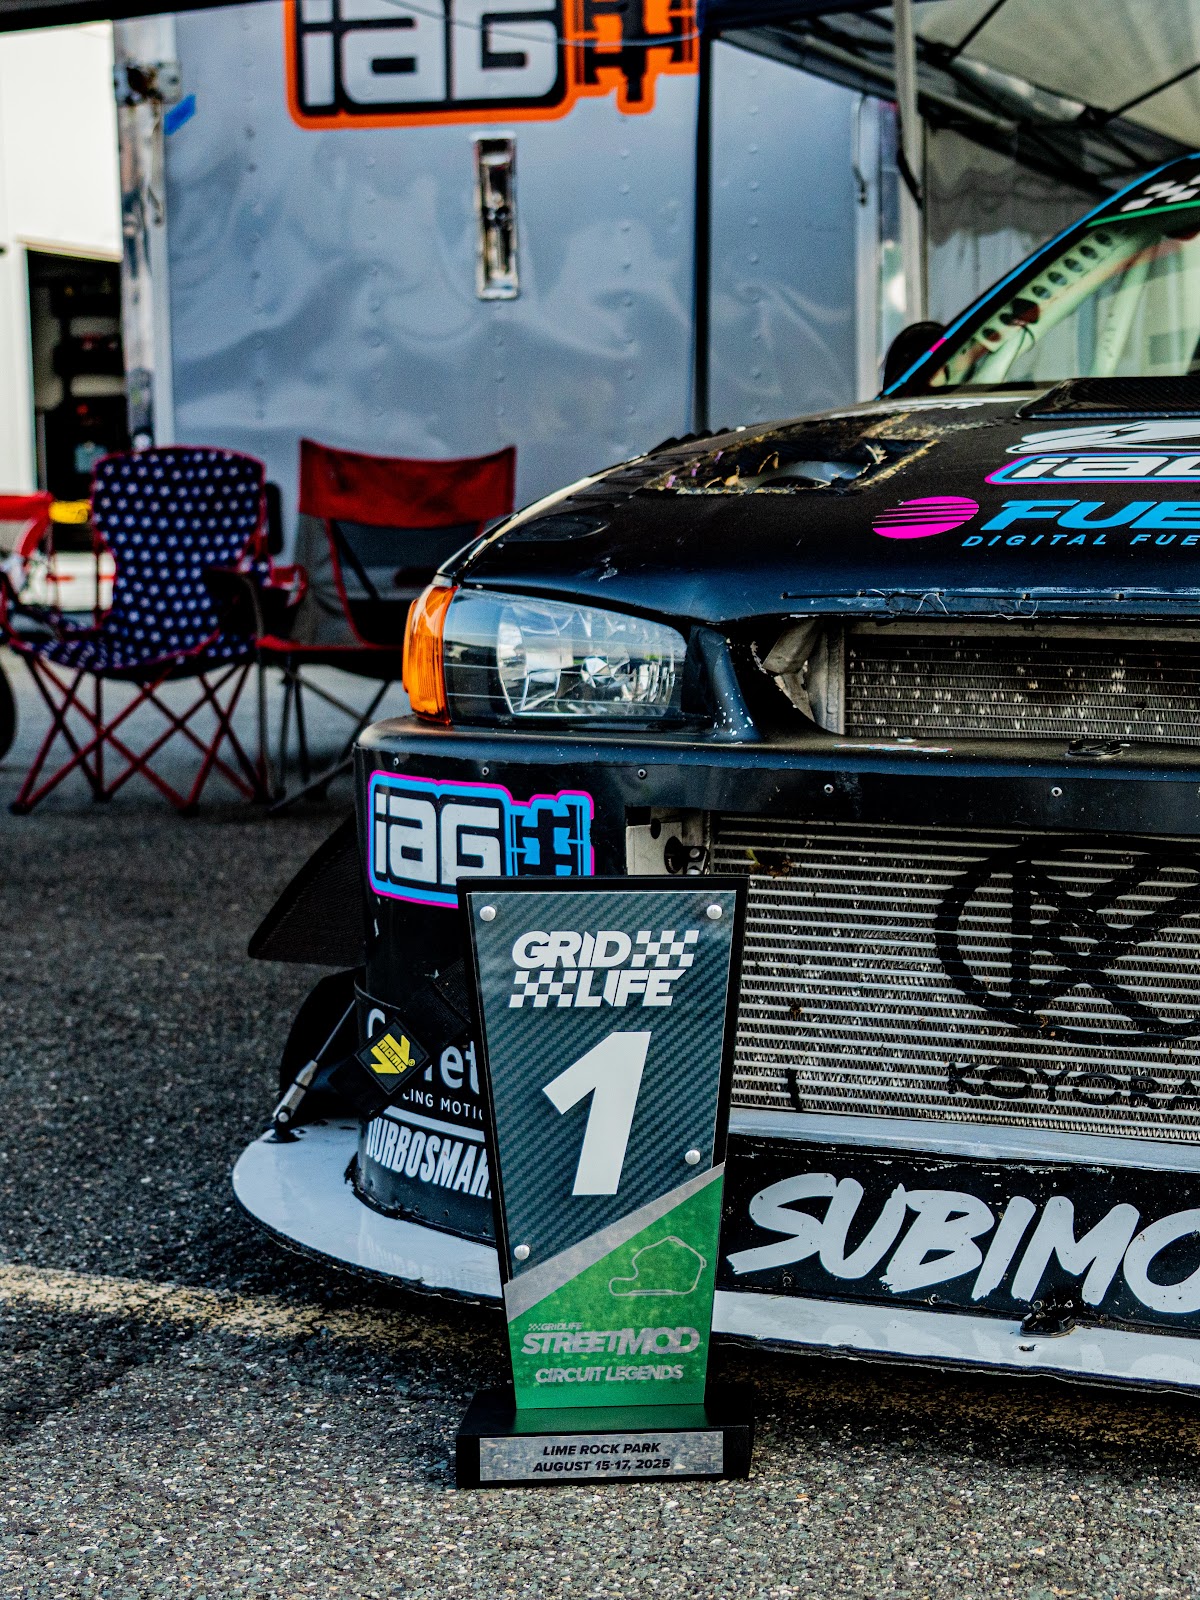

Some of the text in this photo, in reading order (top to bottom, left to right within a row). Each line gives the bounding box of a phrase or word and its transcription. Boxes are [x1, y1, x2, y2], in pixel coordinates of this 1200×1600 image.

[961, 535, 1106, 547] DIGITAL
[512, 930, 632, 968] GRID
[571, 969, 686, 1008] LIFE
[440, 1097, 483, 1120] MOTI
[542, 1031, 652, 1196] 1
[535, 1364, 685, 1384] CIRCUIT LEGENDS
[543, 1442, 661, 1456] LIME ROCK PARK
[533, 1459, 671, 1473] AUGUST 15-17, 2025
